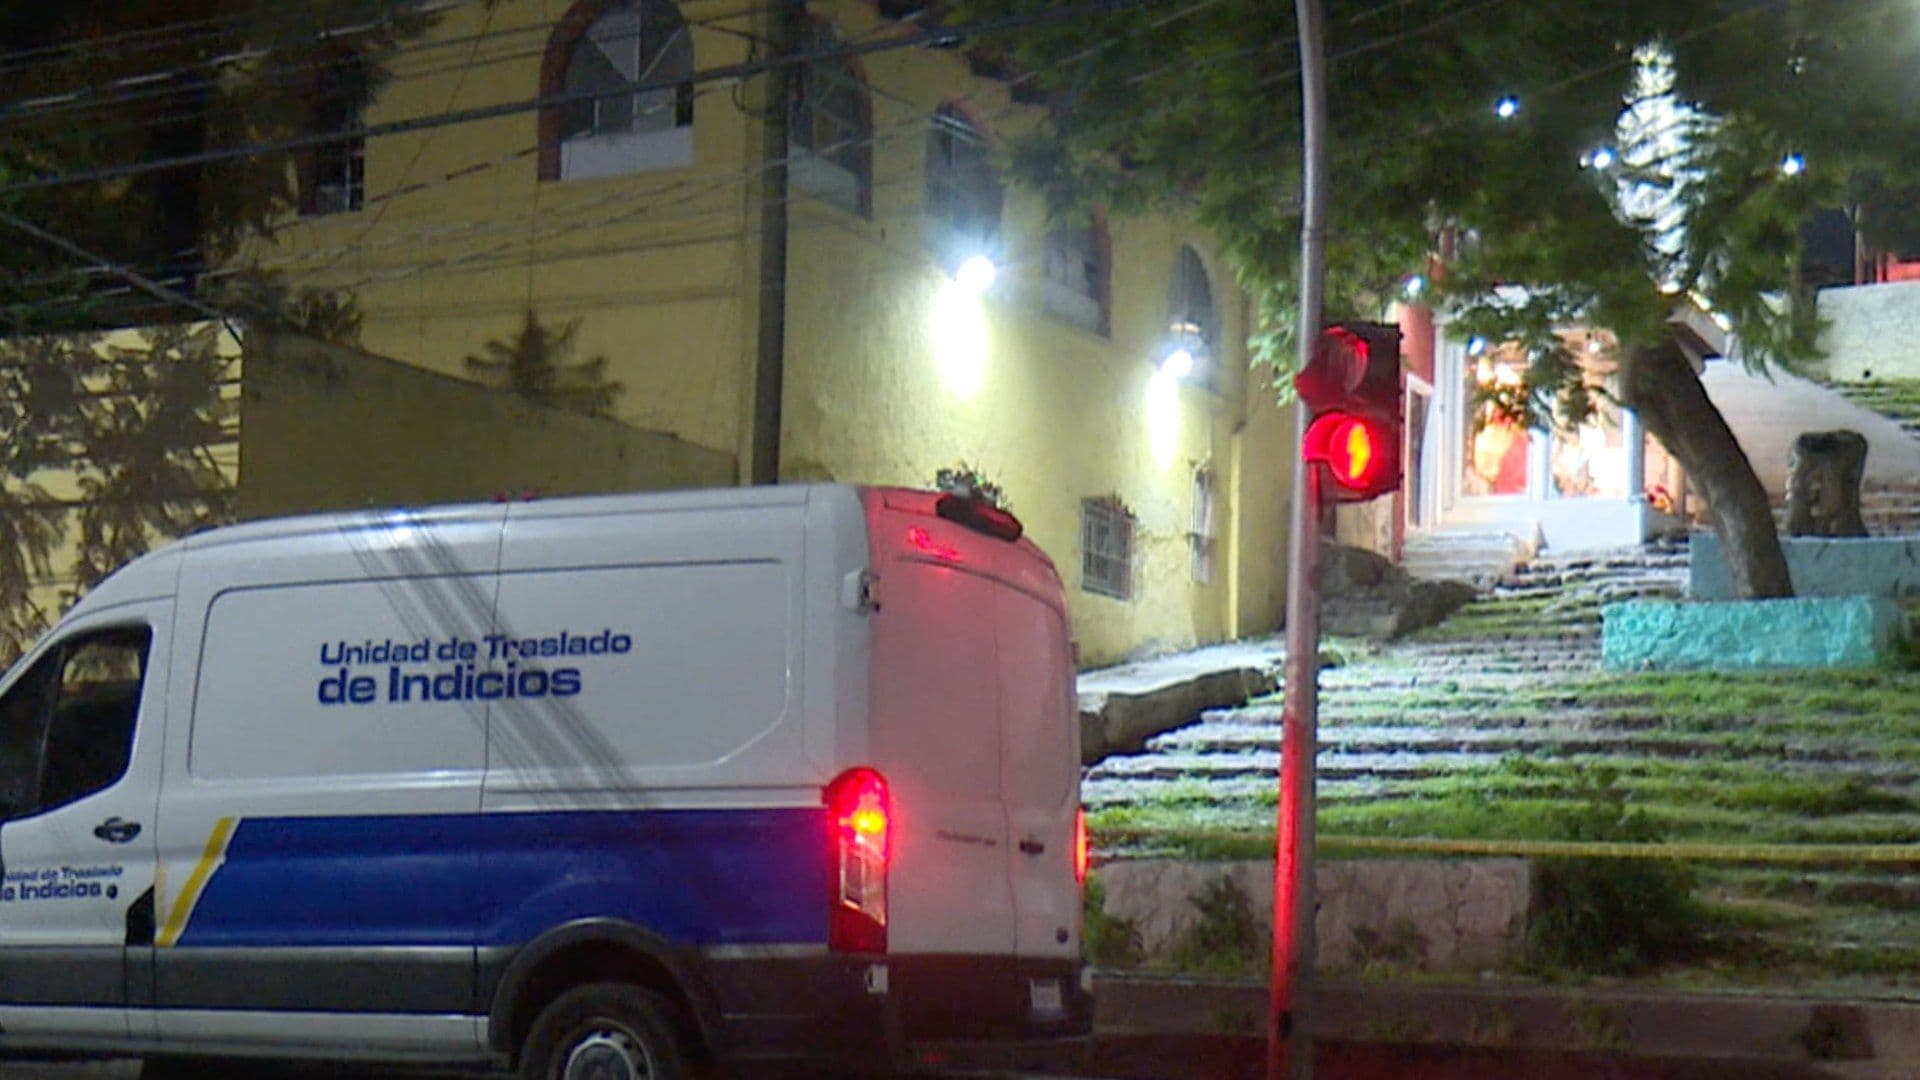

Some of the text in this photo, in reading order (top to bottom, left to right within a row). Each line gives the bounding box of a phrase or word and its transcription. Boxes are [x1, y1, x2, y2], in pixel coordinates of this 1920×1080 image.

[321, 629, 632, 665] Unidad de Traslado
[318, 661, 582, 705] de Indicios
[20, 881, 101, 900] Indicios
